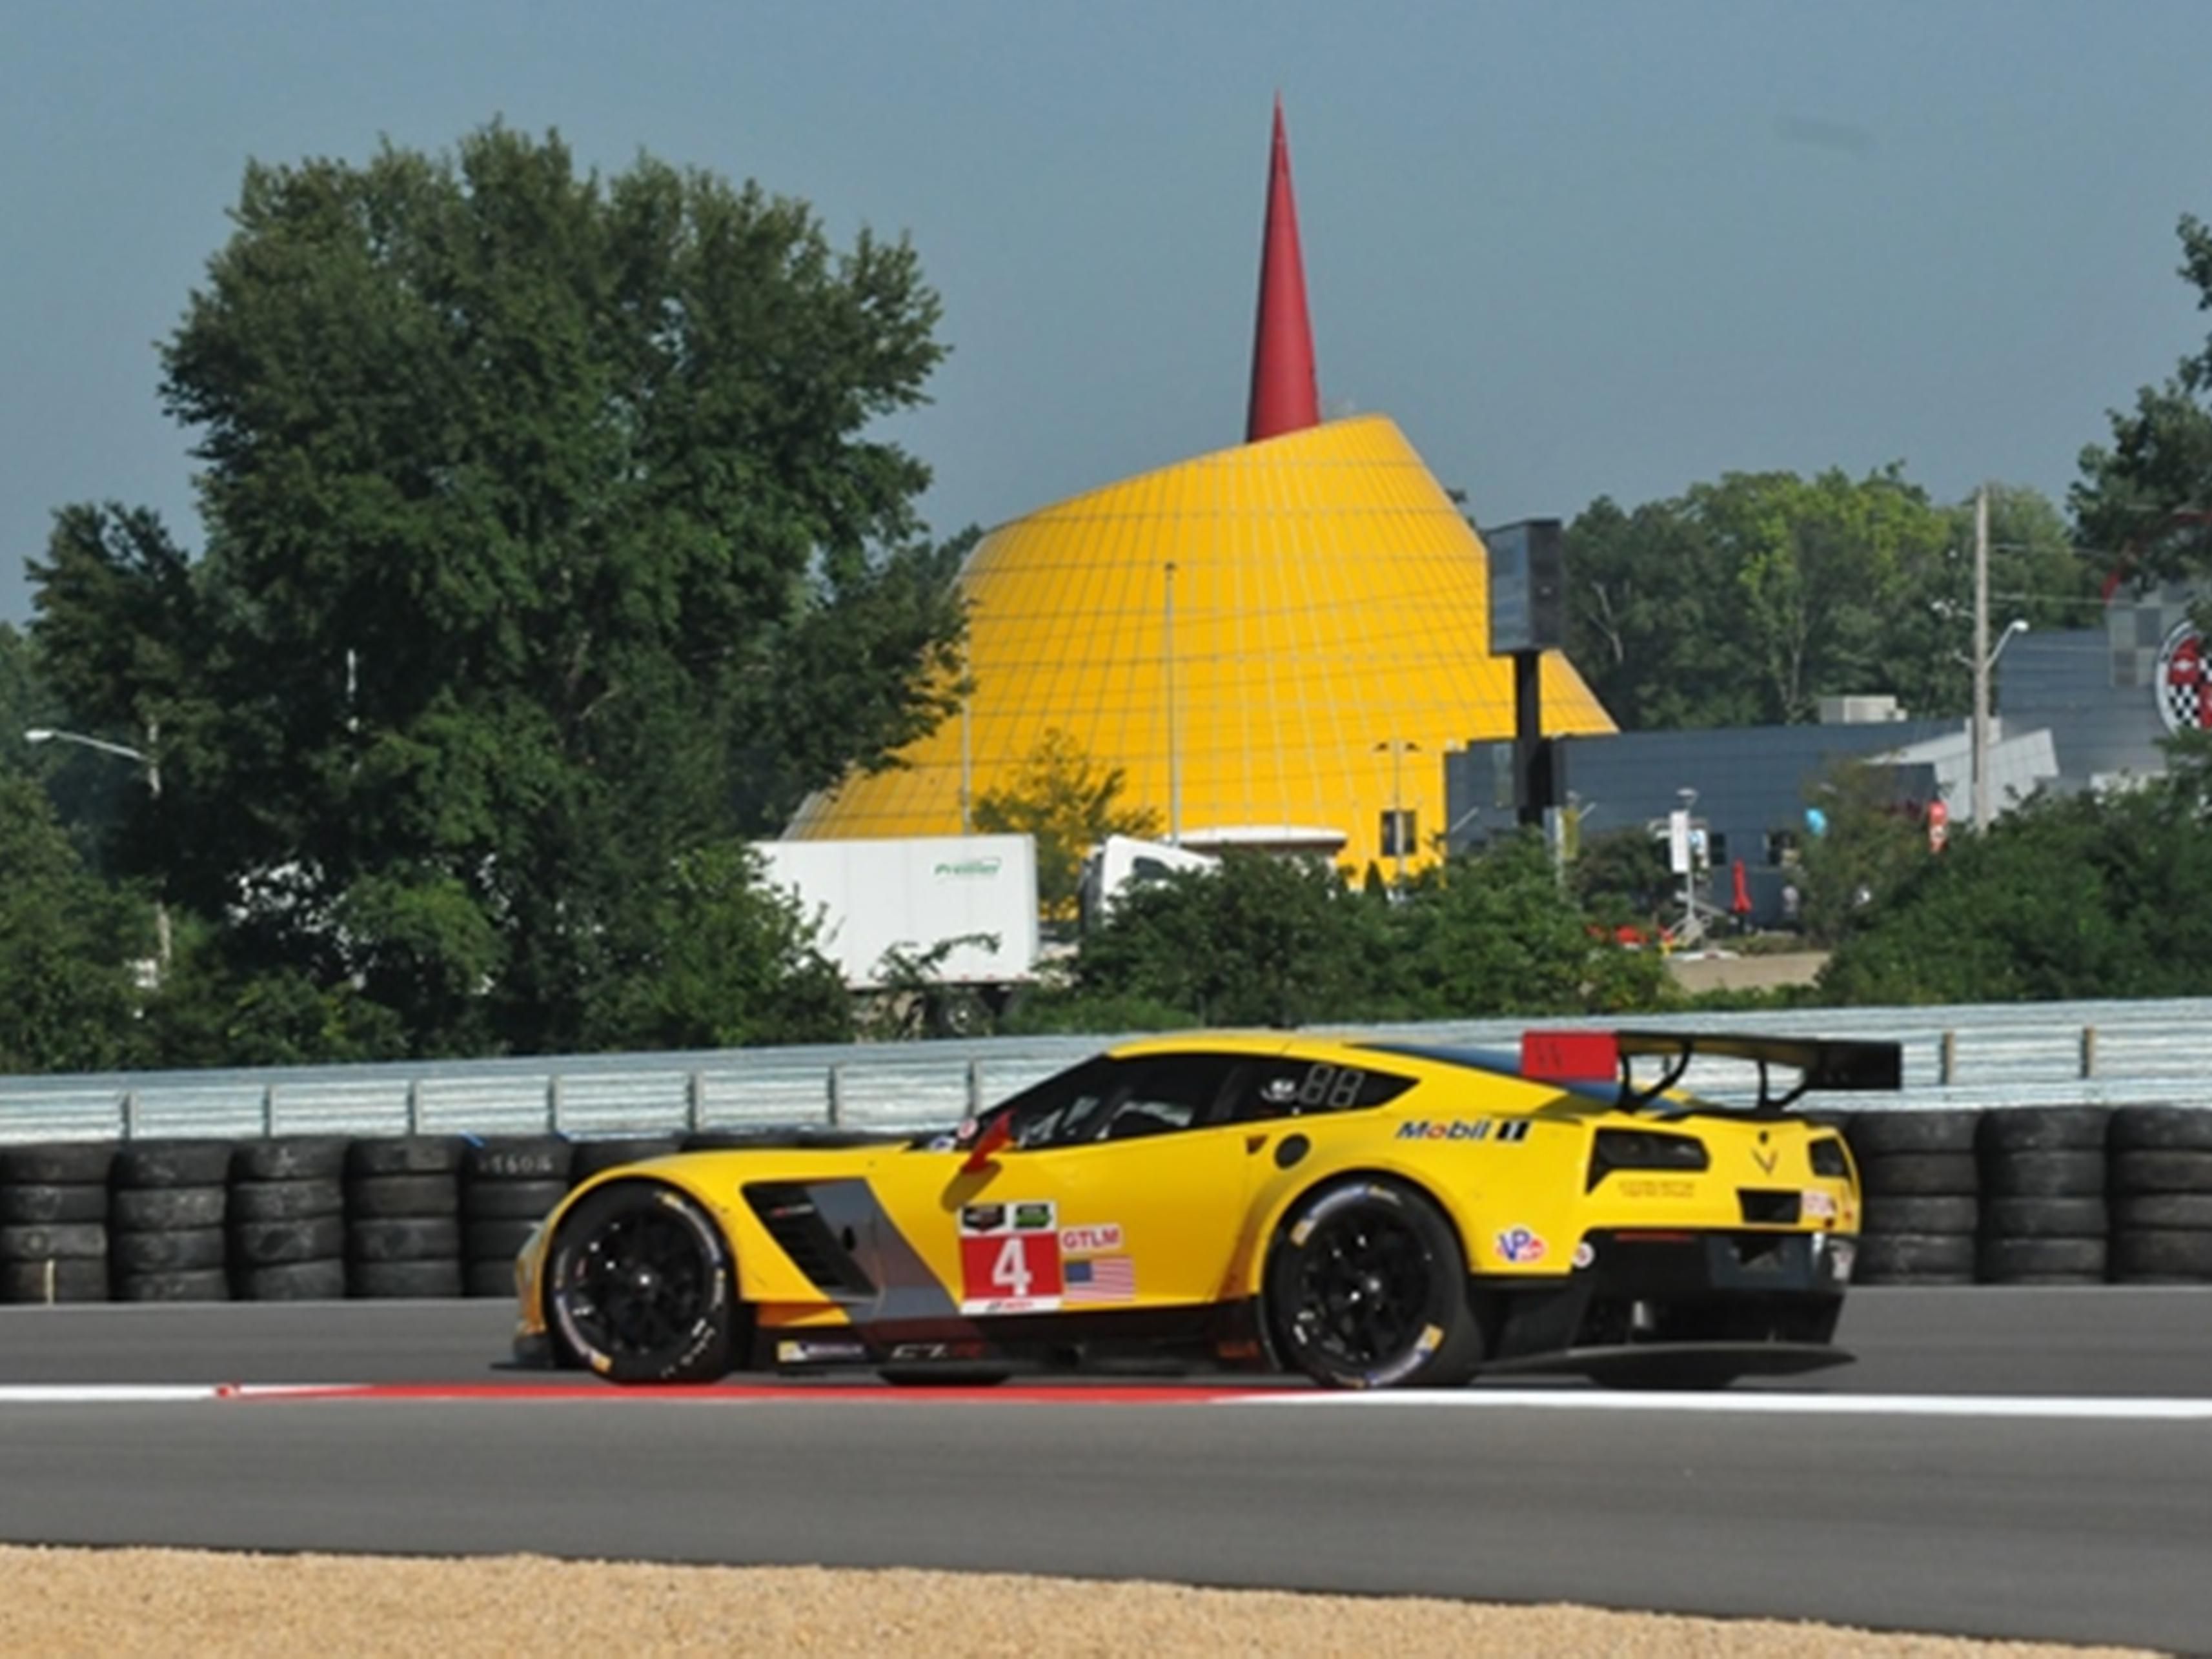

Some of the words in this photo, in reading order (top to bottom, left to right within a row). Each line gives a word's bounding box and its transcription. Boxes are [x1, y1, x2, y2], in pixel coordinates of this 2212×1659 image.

[1396, 1119, 1492, 1139] Mobil
[1064, 1227, 1119, 1248] GTLM
[1500, 1229, 1530, 1261] VP
[991, 1236, 1032, 1296] 4
